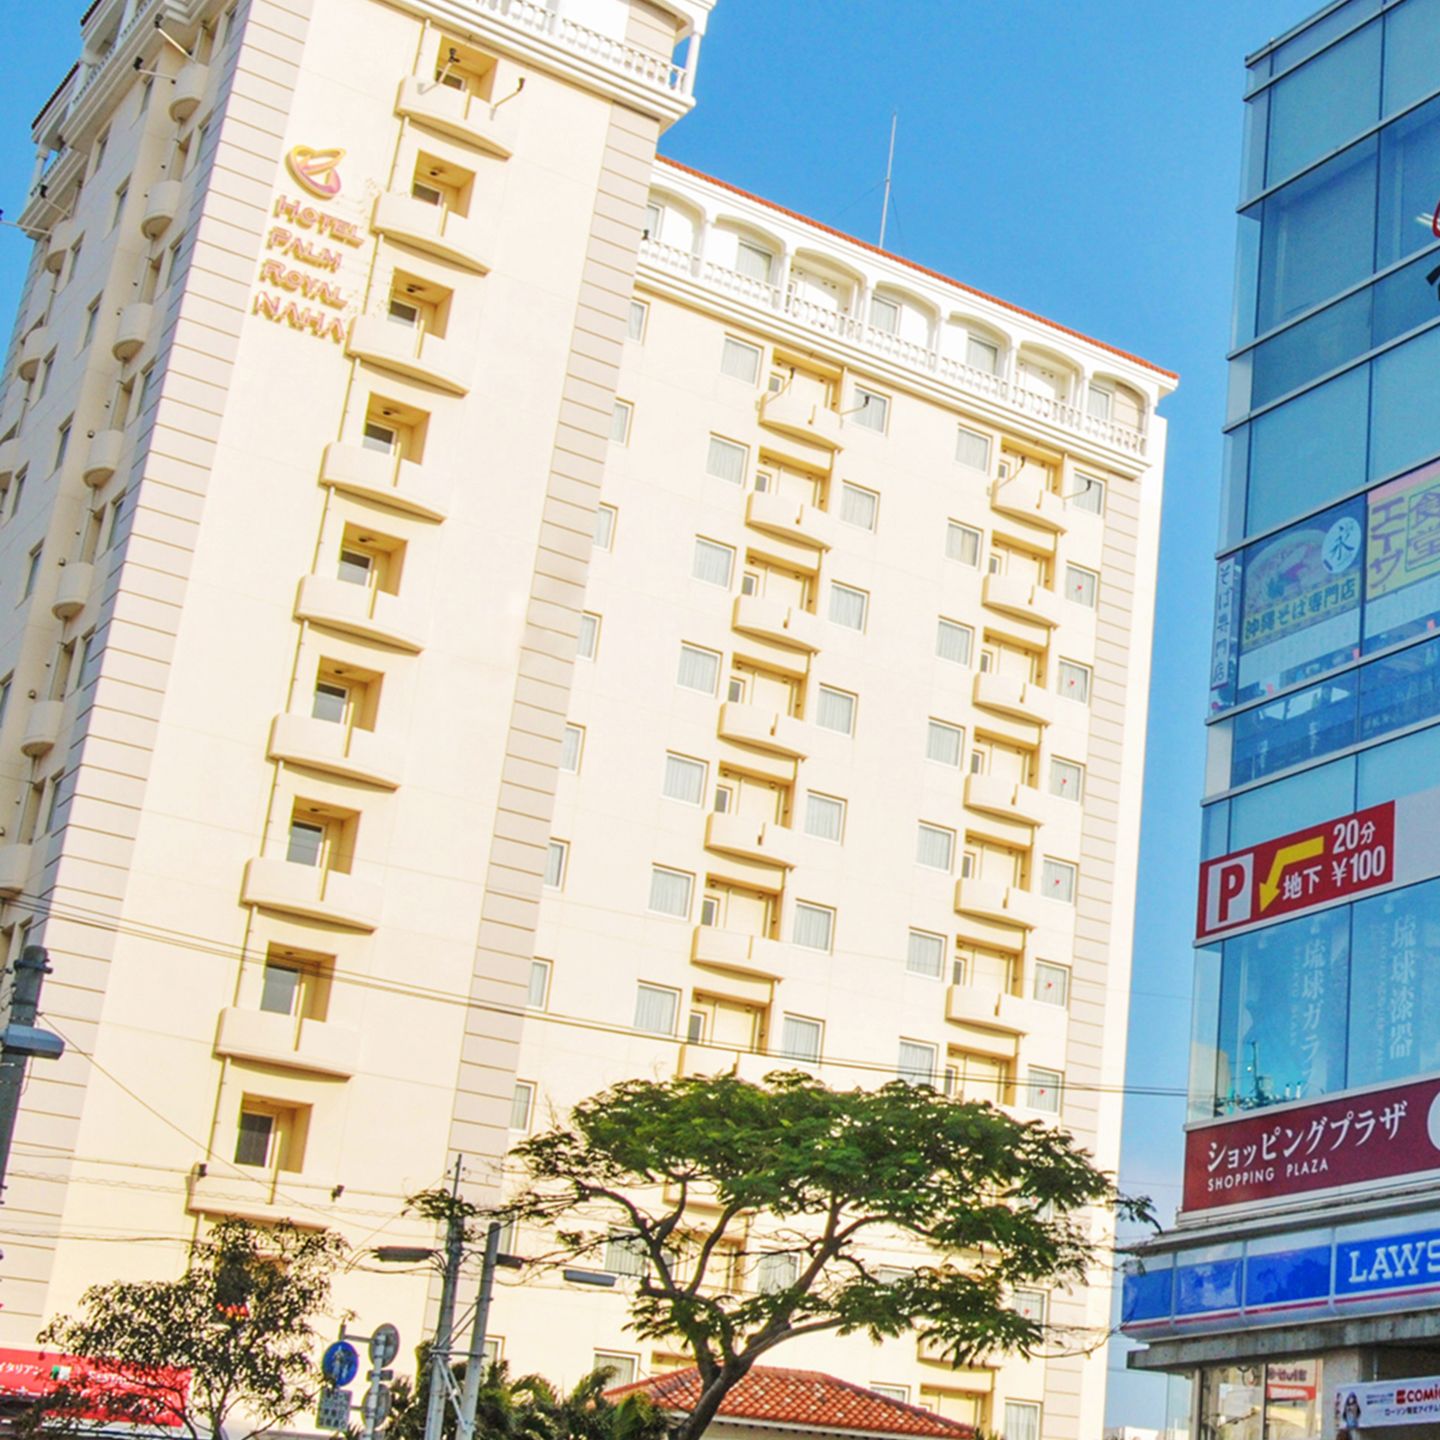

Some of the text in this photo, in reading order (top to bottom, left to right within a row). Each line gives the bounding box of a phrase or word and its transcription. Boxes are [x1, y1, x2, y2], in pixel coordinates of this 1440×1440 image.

[273, 195, 364, 249] HOTEL
[266, 226, 343, 274] PALM
[259, 258, 348, 311] ROYAL
[252, 291, 346, 344] NAHA
[1245, 576, 1357, 640] 沖縄そば専門店
[1332, 819, 1376, 854] 20分
[1218, 863, 1245, 923] P
[1283, 845, 1386, 900] 地下 ¥100
[1207, 1100, 1408, 1173] ショッピングプラザ
[1207, 1157, 1329, 1192] SHOPPING PLAZA
